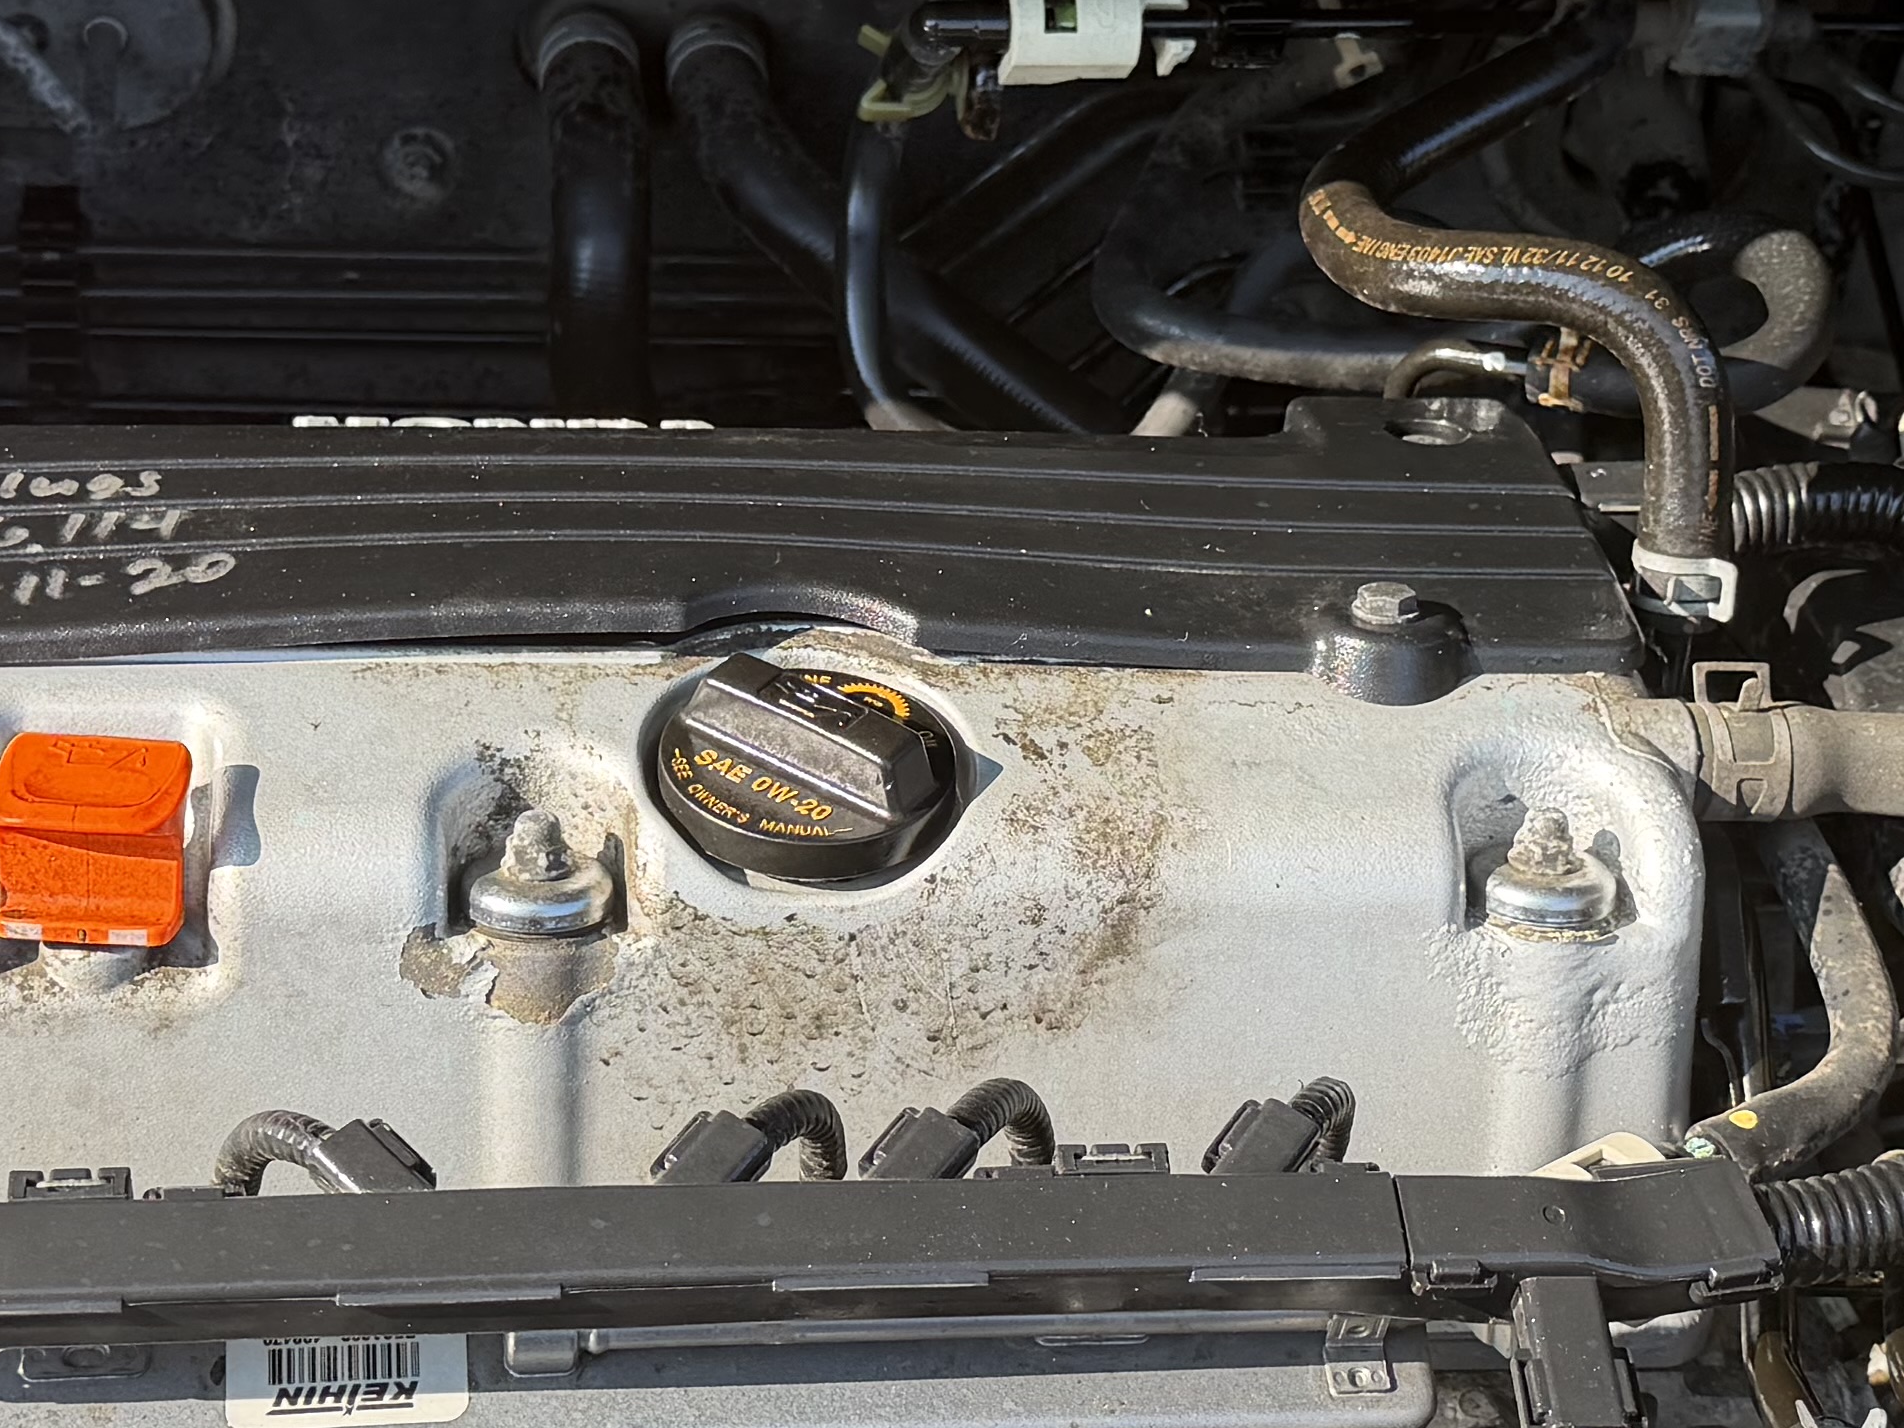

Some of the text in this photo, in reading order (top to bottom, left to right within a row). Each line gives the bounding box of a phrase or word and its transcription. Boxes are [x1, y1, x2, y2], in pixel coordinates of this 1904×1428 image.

[1463, 245, 1499, 265] SAE
[1691, 353, 1716, 388] DOT
[693, 748, 835, 821] SAE 0W-20
[687, 782, 751, 824] OWNER'S
[759, 819, 835, 837] MANUAL
[270, 1380, 420, 1412] KEIHIN
